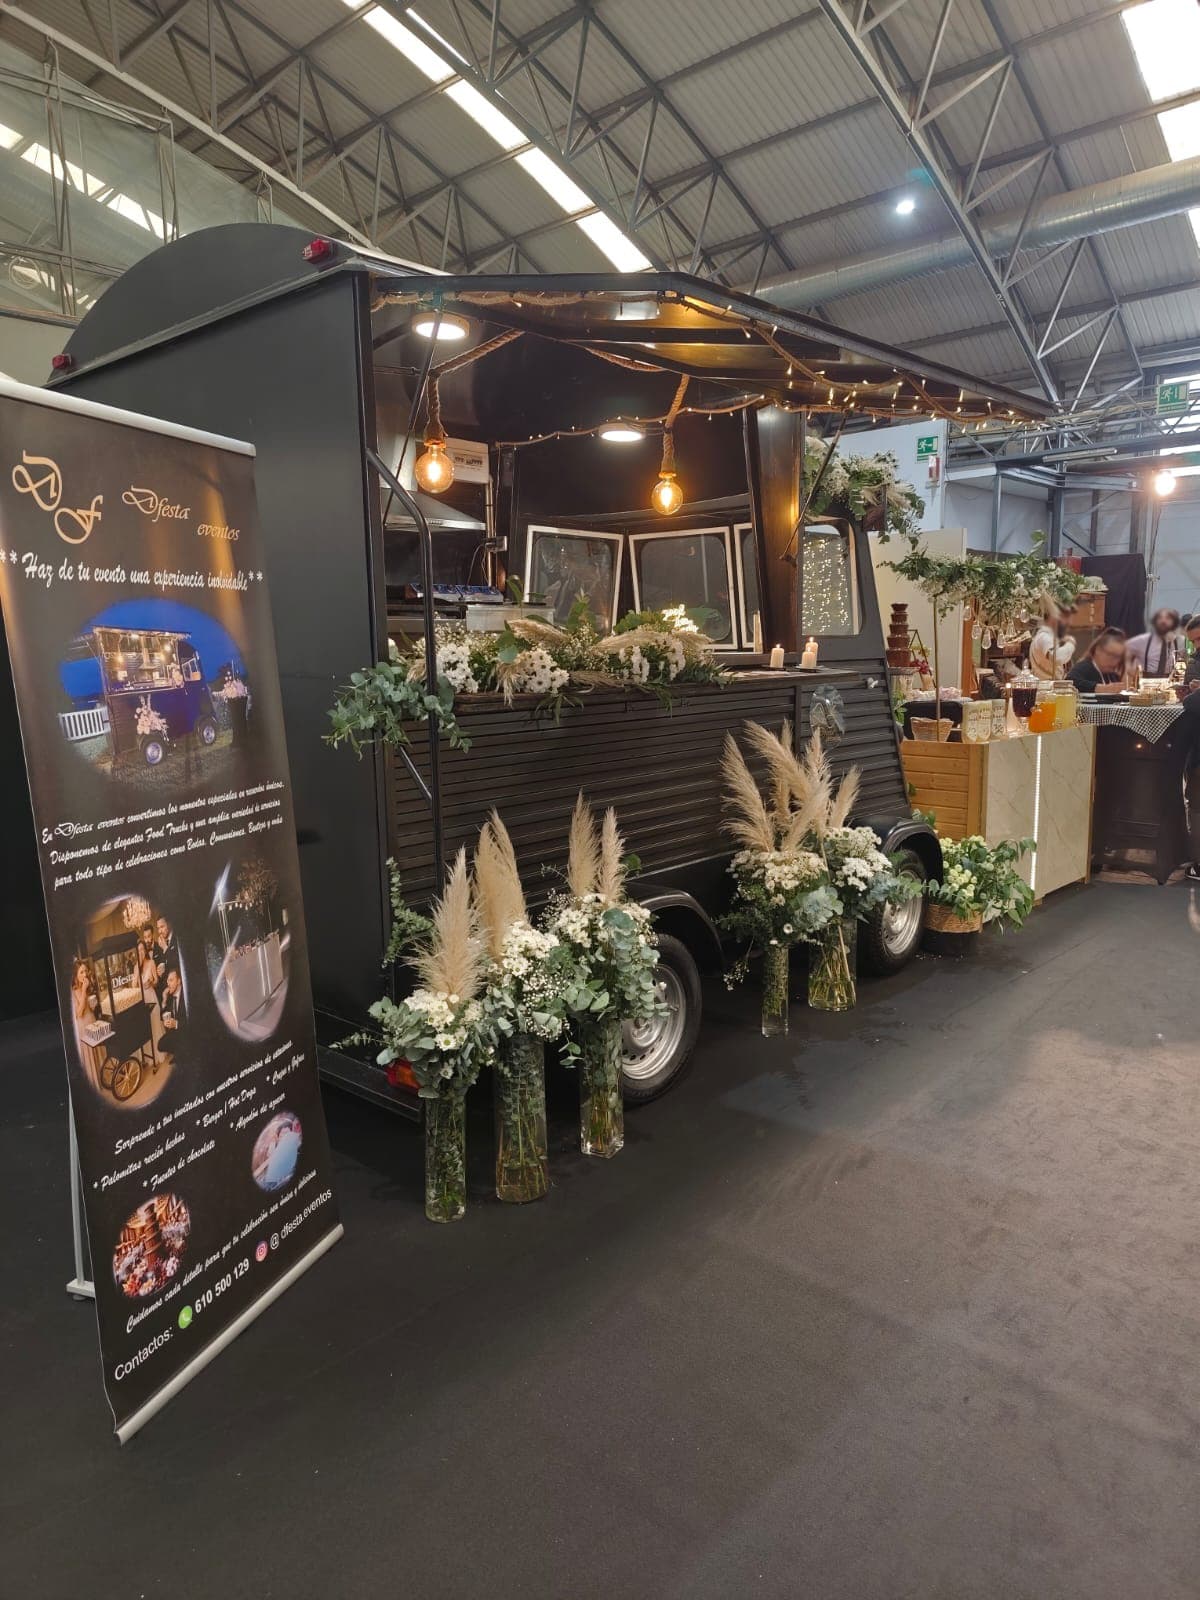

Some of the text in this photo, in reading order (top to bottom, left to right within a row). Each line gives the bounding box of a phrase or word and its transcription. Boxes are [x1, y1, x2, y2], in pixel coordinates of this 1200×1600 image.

[121, 484, 191, 522] Dfesta
[197, 523, 240, 541] eventos
[58, 557, 74, 581] de
[78, 561, 91, 582] tu
[94, 564, 126, 583] evento
[130, 570, 151, 585] una
[153, 569, 205, 592] experiencia
[97, 816, 126, 830] eventos
[126, 807, 166, 824] convertimos
[167, 802, 178, 815] los
[207, 789, 238, 806] especiales
[49, 844, 99, 865] Disponemos
[102, 839, 112, 852] de
[113, 833, 144, 851] elegantes
[145, 825, 165, 843] Food
[166, 820, 188, 836] Trucks
[189, 822, 195, 832] y
[54, 873, 73, 891] para
[75, 866, 94, 882] todo
[96, 864, 113, 878] tipo
[115, 859, 124, 871] de
[125, 848, 169, 868] celebraciones
[169, 845, 186, 856] como
[114, 1123, 155, 1155] Sorprende
[156, 1121, 161, 1130] a
[162, 1113, 173, 1127] tus
[174, 1095, 204, 1119] invitados
[205, 1089, 216, 1101] con
[202, 1109, 224, 1128] Burger
[227, 1096, 240, 1110] Hot
[240, 1086, 257, 1102] Dogs
[100, 1131, 186, 1192] Palomitas recién hechas
[150, 1139, 215, 1192] Fuentes de chocolate
[114, 1188, 332, 1381] Contactos: 610 500 129 @ dfesta.eventos
[126, 1297, 163, 1334] Cuidamos
[164, 1282, 181, 1302] cada
[182, 1262, 204, 1287] detalle
[204, 1251, 220, 1272] para
[221, 1241, 232, 1259] que
